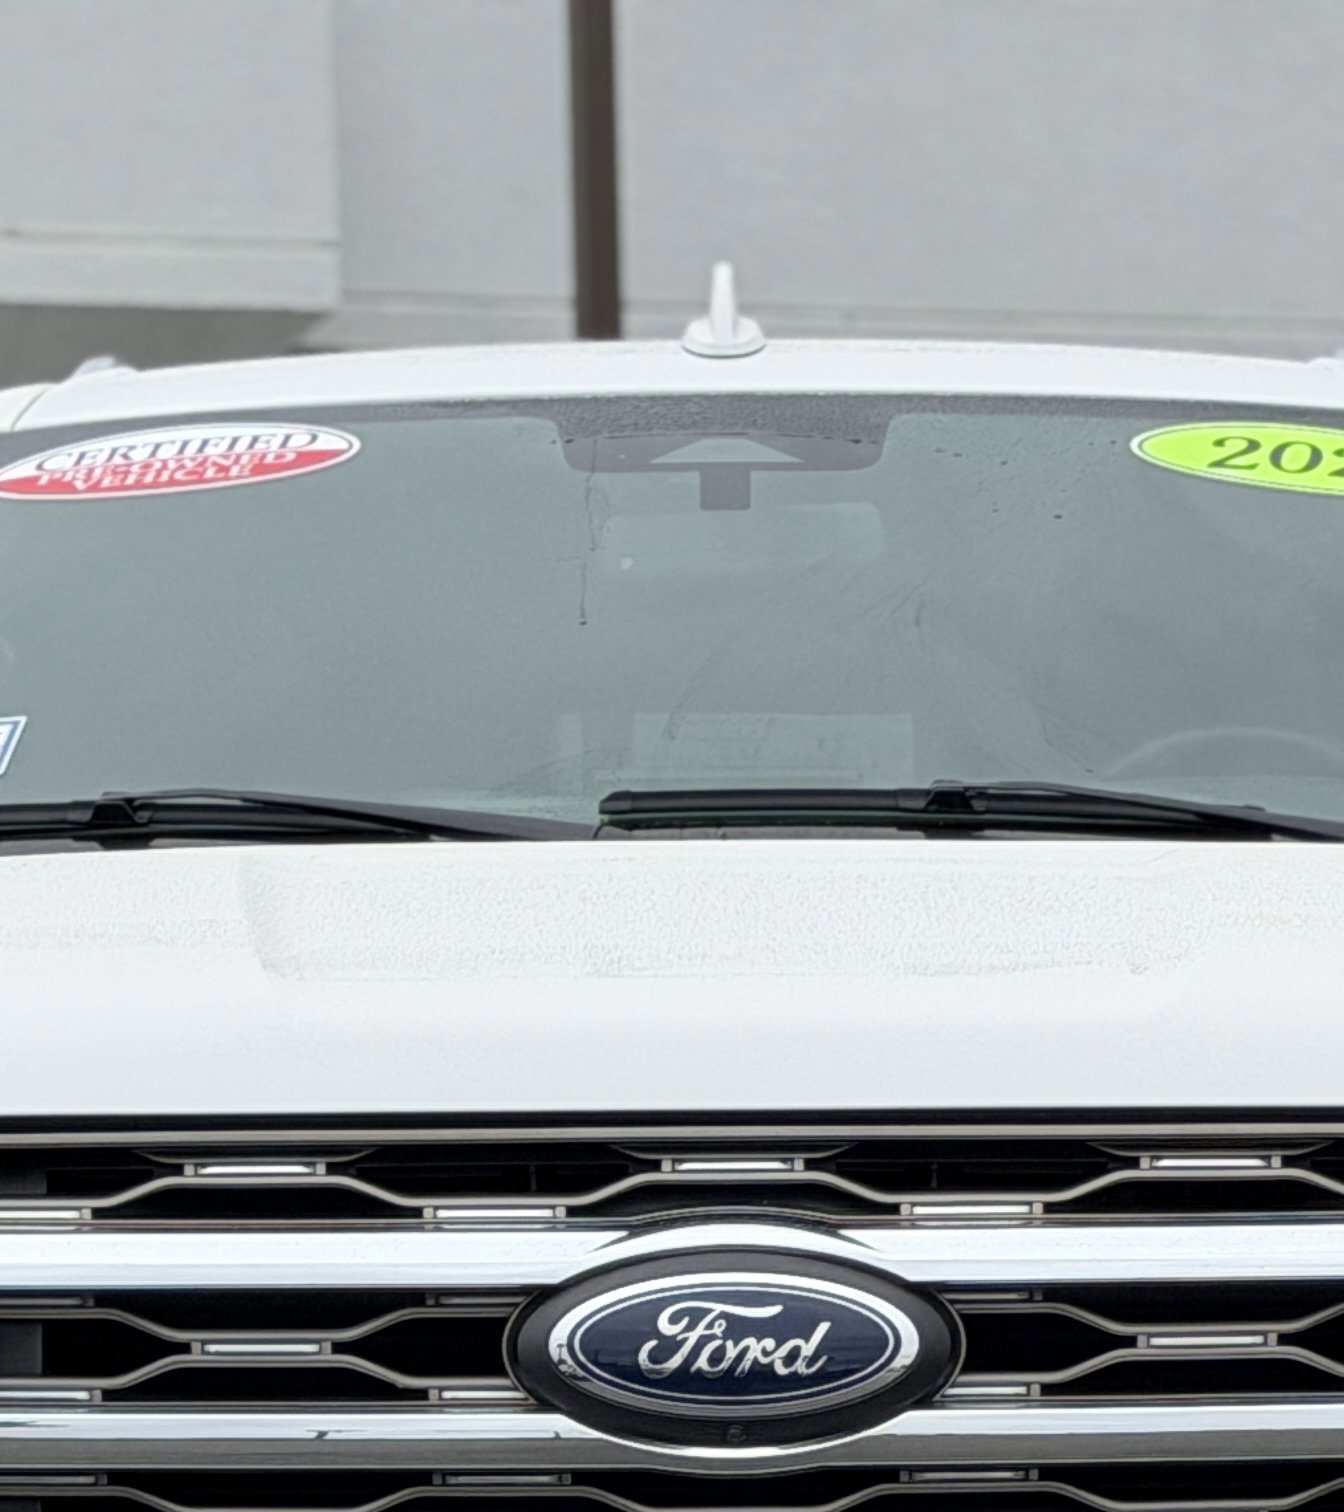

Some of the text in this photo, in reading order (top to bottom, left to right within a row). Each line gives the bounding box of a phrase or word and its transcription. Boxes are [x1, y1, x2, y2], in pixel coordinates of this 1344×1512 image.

[35, 432, 318, 471] CERTIFIED
[72, 464, 254, 490] VEHICLE
[638, 1300, 832, 1379] Ford
